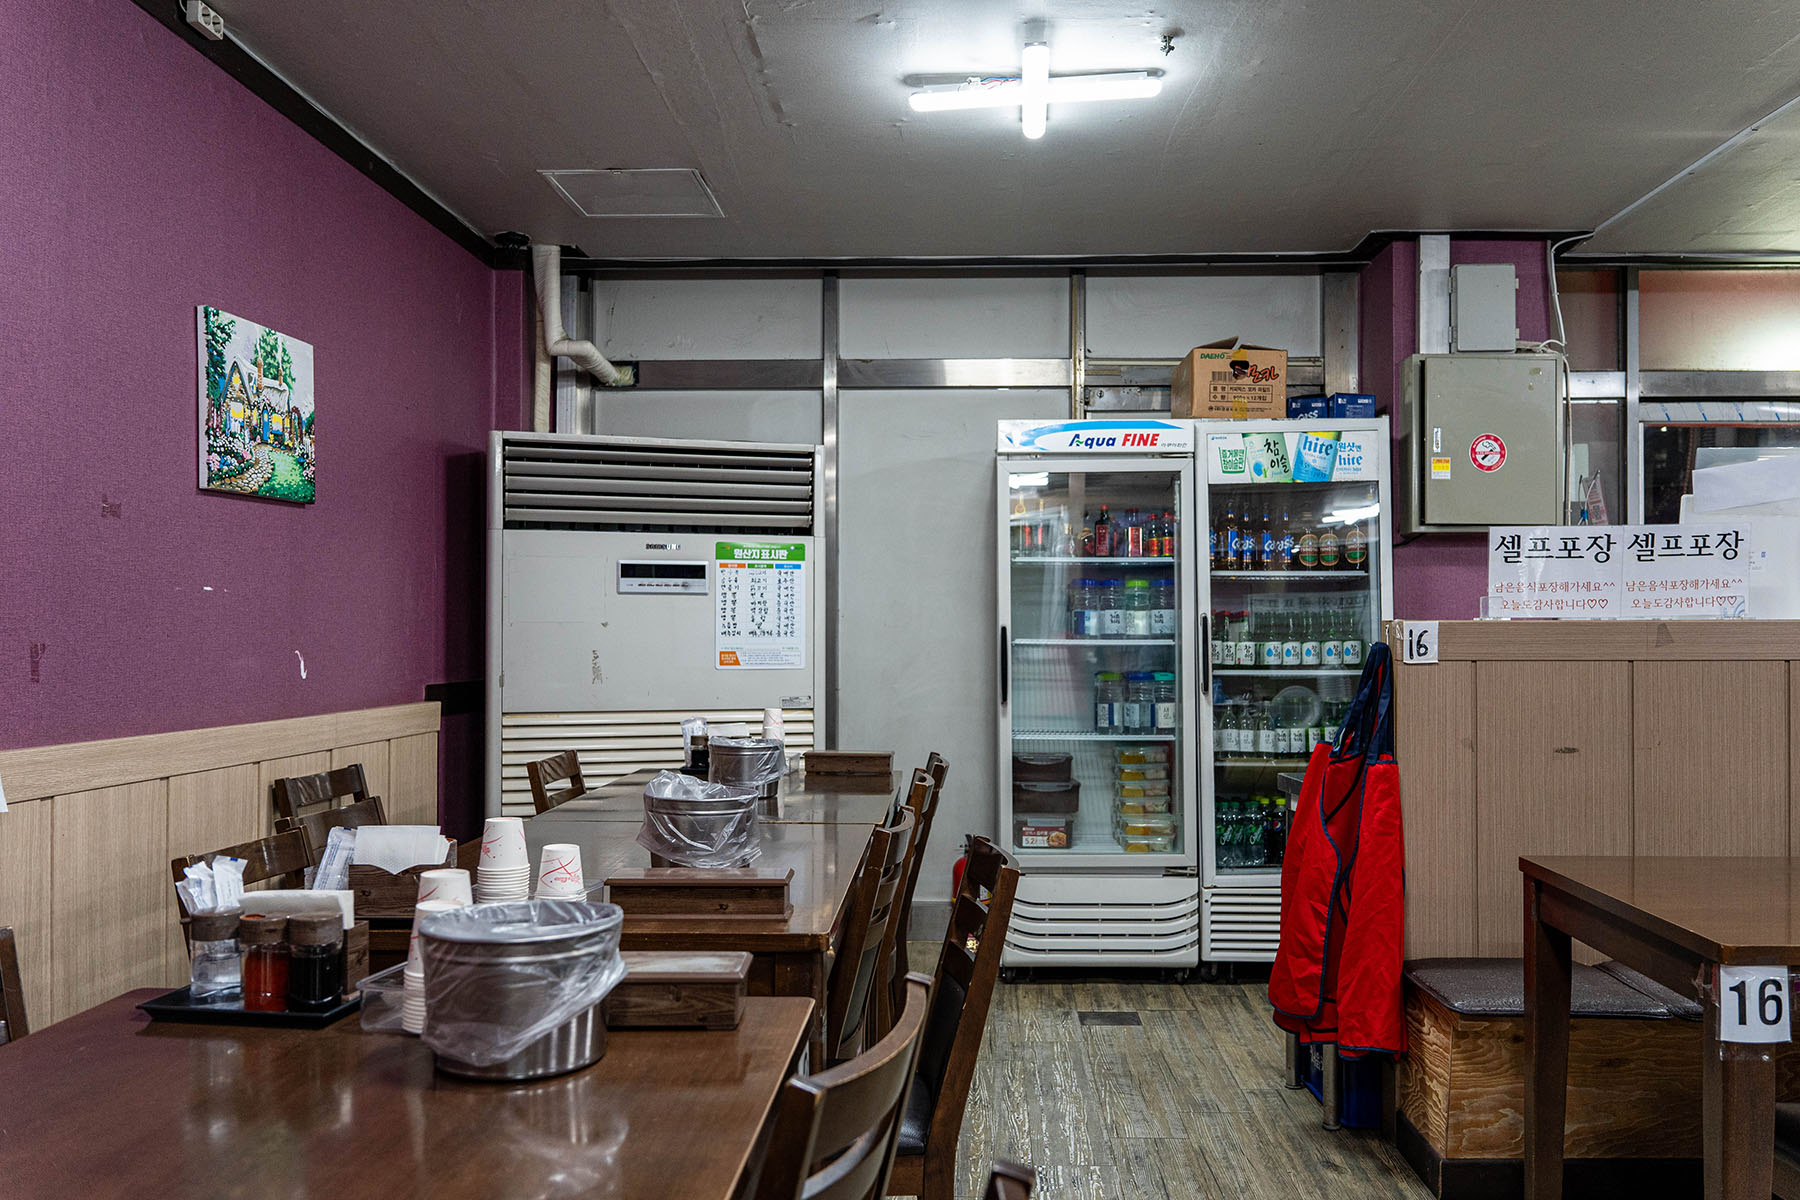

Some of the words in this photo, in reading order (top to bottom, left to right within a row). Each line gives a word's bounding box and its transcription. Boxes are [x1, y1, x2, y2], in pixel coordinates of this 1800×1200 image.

[1068, 433, 1117, 449] Aqua
[1121, 433, 1160, 447] FINE
[1302, 436, 1333, 456] hite
[1338, 454, 1363, 466] hite
[733, 548, 760, 559] 원산지
[761, 549, 789, 560] 표시판
[1494, 533, 1617, 564] 셀프포장
[1627, 530, 1745, 562] 셀프포장
[1408, 629, 1429, 660] 16
[1728, 978, 1784, 1026] 16
